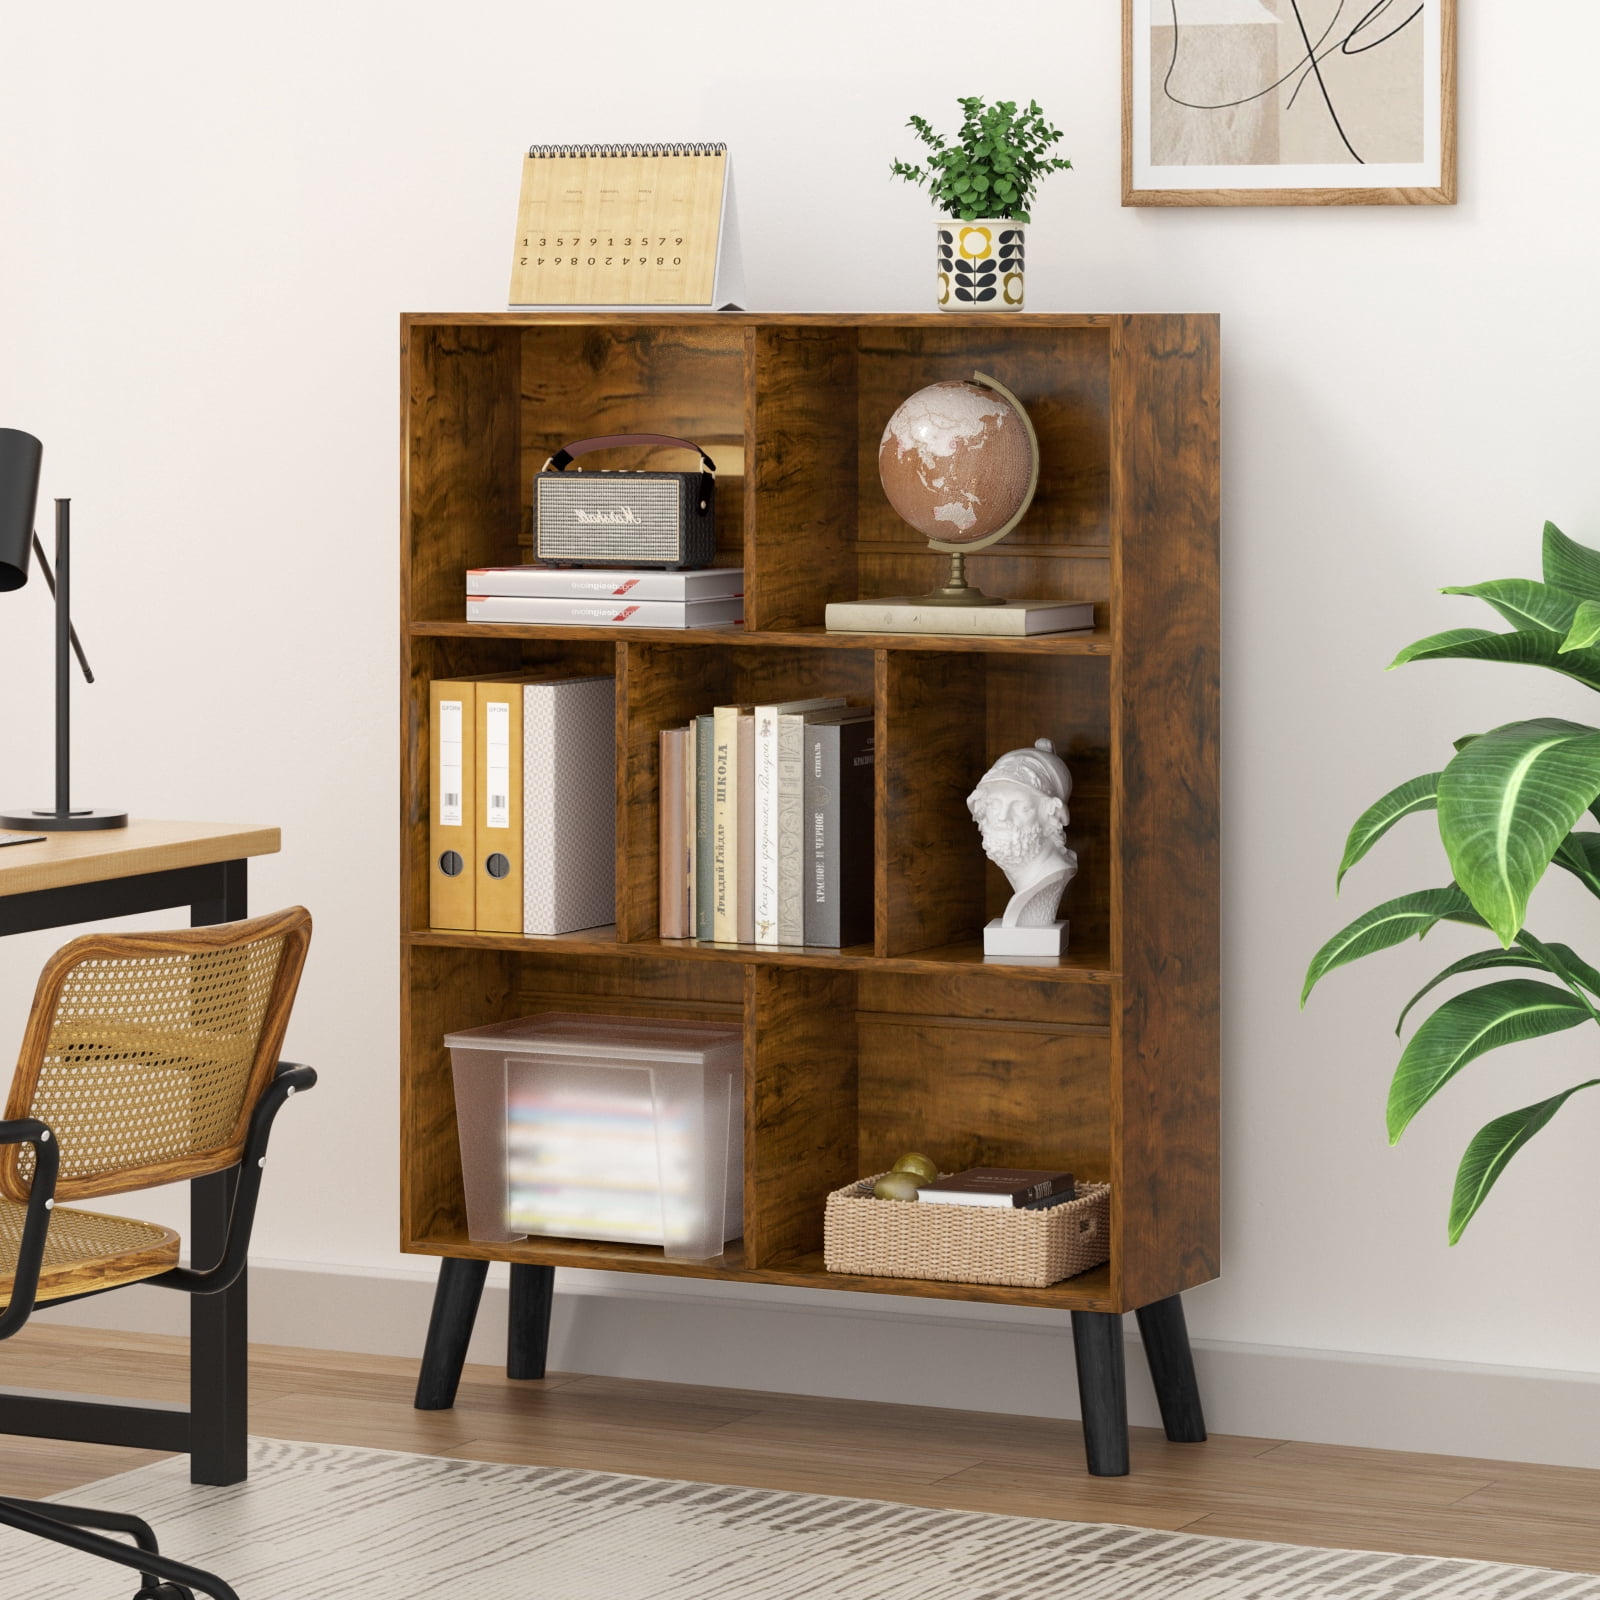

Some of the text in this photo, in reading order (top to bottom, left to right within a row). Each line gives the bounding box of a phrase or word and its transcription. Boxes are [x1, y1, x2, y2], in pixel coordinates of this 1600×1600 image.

[523, 239, 529, 247] 1
[540, 239, 547, 247] 3
[557, 239, 564, 247] 5
[574, 238, 581, 247] 7
[608, 238, 613, 247] 1
[625, 238, 632, 246] 3
[642, 238, 649, 246] 5
[659, 238, 666, 246] 7
[676, 238, 683, 246] 9
[716, 743, 728, 803] ШКОЛА
[814, 812, 825, 903] КРАСНОЕ И ЧЕРНОЕ
[759, 865, 775, 917] Сказки
